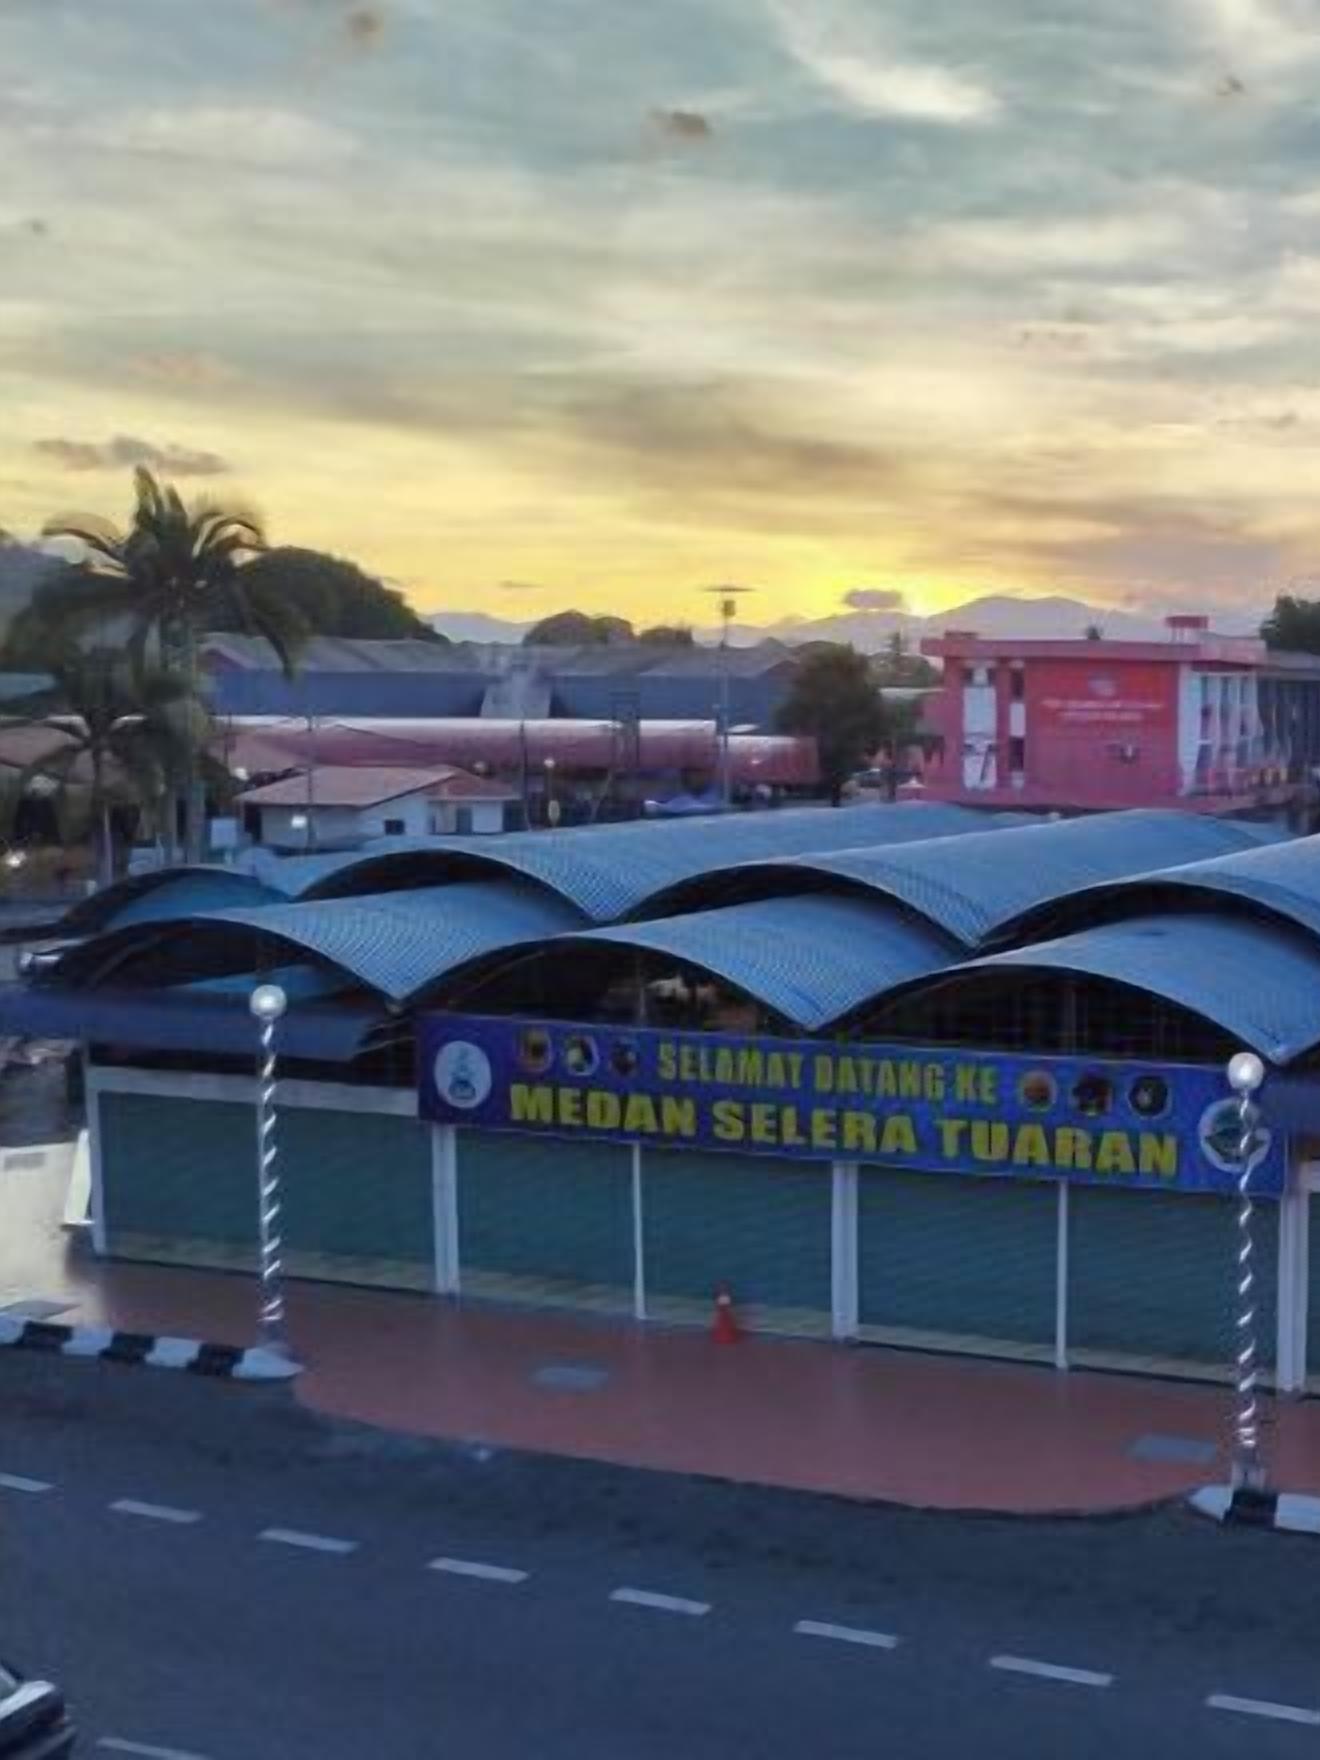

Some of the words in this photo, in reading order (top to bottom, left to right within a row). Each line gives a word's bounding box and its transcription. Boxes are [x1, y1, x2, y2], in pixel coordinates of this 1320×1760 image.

[657, 1042, 803, 1089] SELAMAT
[815, 1055, 946, 1101] DATANG
[955, 1064, 997, 1104] KE
[510, 1083, 697, 1137] MEDAN
[712, 1100, 918, 1155] SELERA
[935, 1117, 1178, 1176] TUARAN
